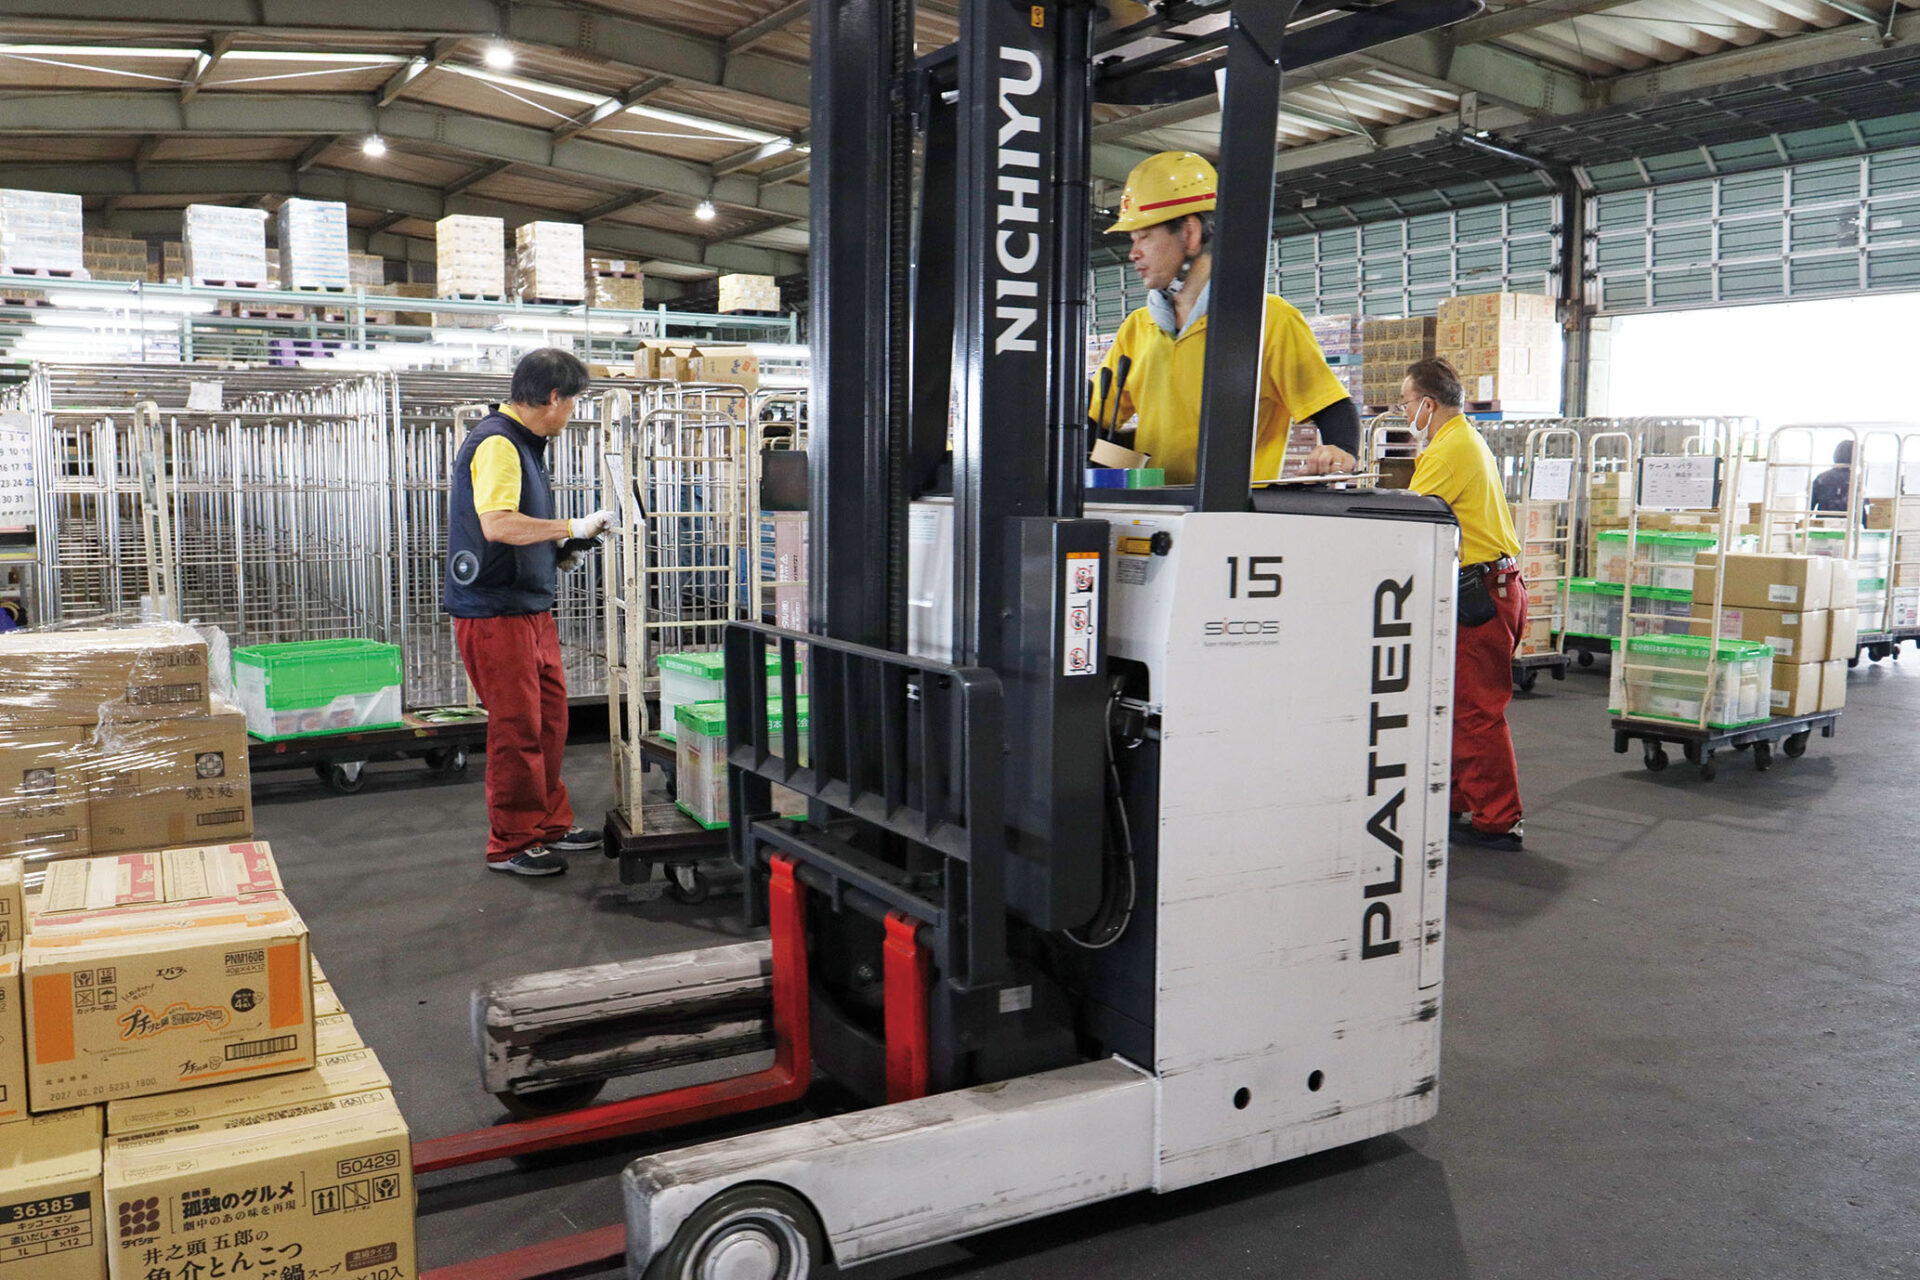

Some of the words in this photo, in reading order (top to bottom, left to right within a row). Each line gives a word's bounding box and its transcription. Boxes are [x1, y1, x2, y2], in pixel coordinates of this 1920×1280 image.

[995, 46, 1043, 356] NICHIYU
[639, 322, 649, 333] M
[1, 480, 10, 488] 23
[13, 479, 22, 487] 24
[2, 496, 12, 504] 30
[15, 495, 24, 503] 31
[1226, 556, 1283, 599] 15
[1361, 574, 1414, 960] PLATTER
[224, 953, 265, 966] PNM160B
[156, 966, 187, 980] エバラ
[341, 1153, 396, 1175] 50429
[182, 1181, 294, 1219] 孤独のグルメ
[13, 1197, 75, 1220] 36385
[183, 1200, 296, 1232] 劇中のあの味を再現
[17, 1215, 72, 1230] キッコーマン
[121, 1236, 160, 1249] ダイショー
[18, 1248, 27, 1256] 1L
